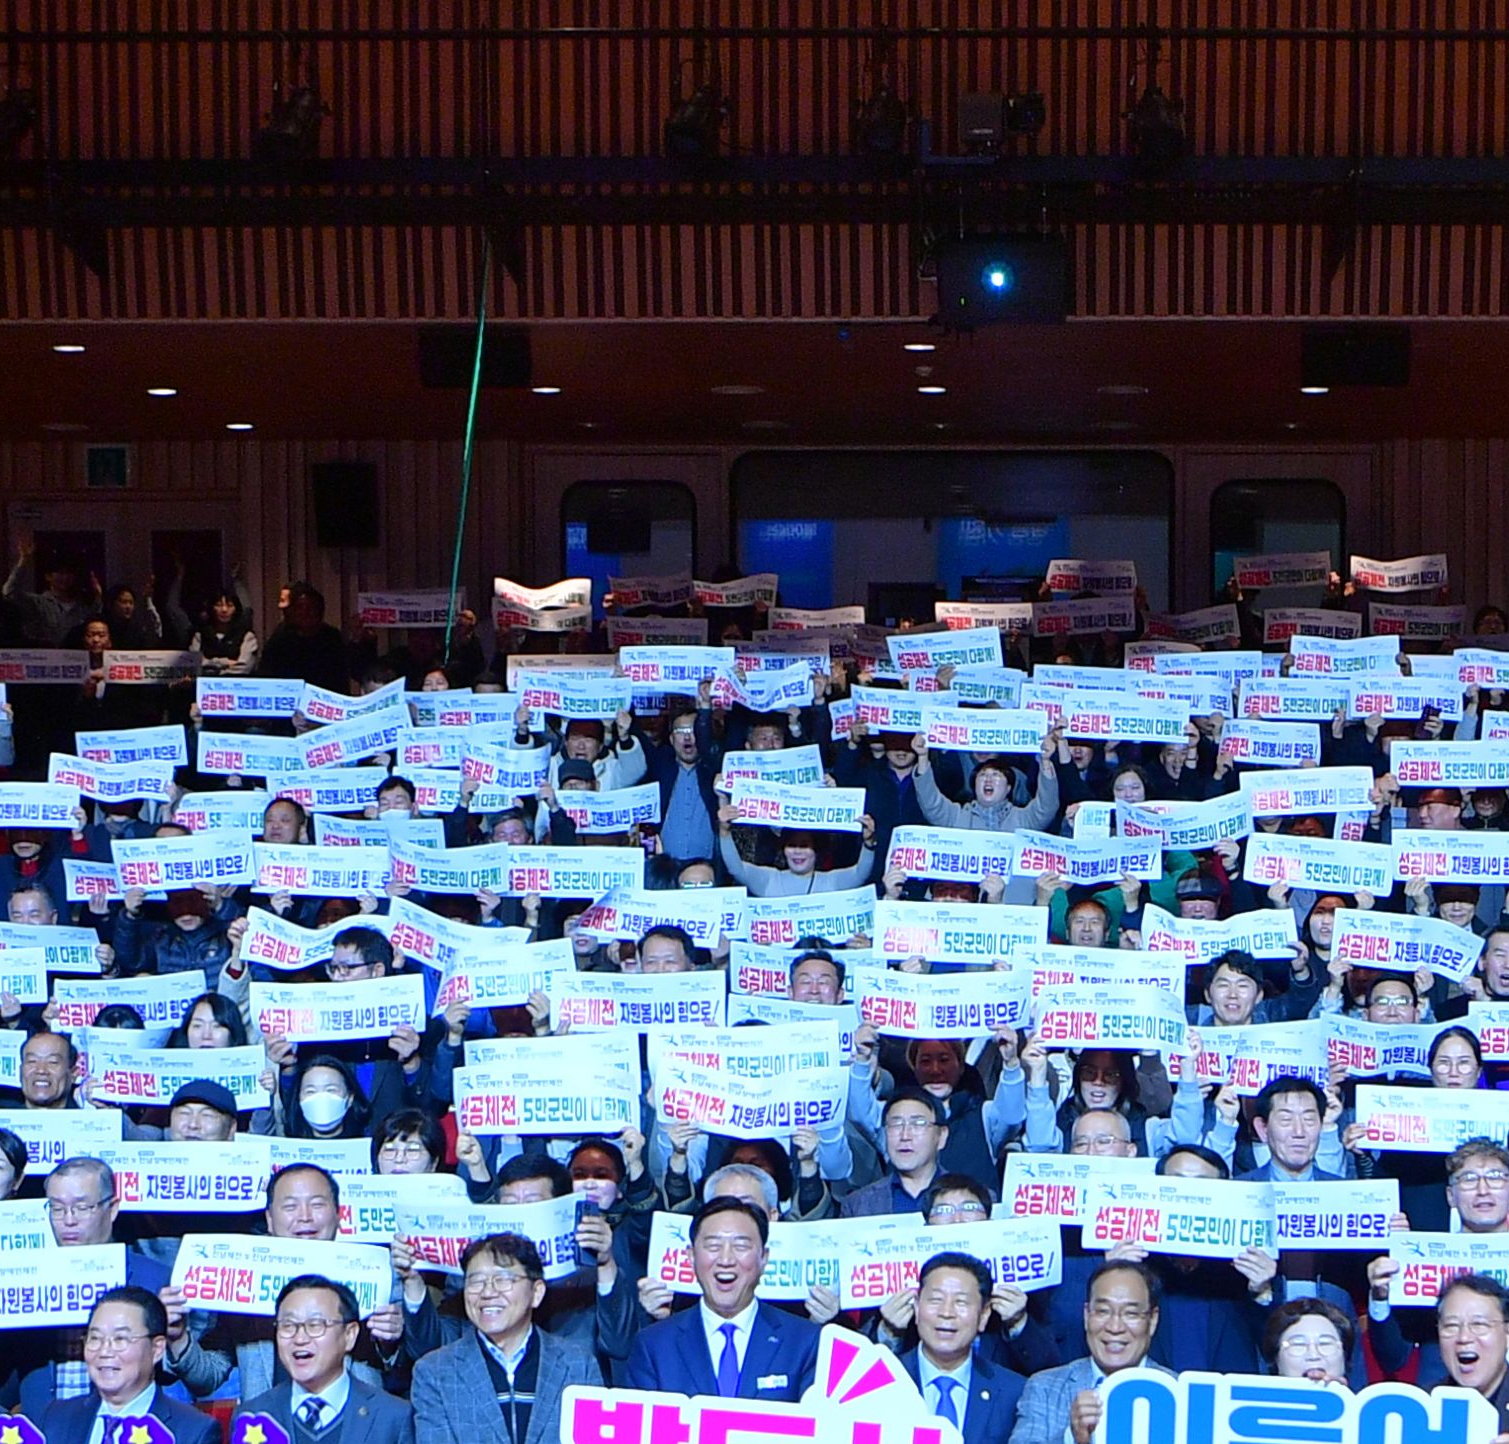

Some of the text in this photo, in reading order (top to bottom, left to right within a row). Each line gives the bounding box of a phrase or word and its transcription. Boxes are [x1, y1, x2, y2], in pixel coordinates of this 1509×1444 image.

[1114, 717, 1154, 733] 5만군민이
[1445, 763, 1486, 779] 5만군민이
[161, 854, 249, 883] 자원봉사의 힘으로!
[1022, 850, 1156, 879] 성공체전, 자원봉사의 힘으로!
[1306, 862, 1354, 884] 5만군민이
[1350, 867, 1385, 887] 다함께!
[1401, 854, 1450, 876] 성공체전,
[1452, 856, 1504, 875] 자원봉사의
[420, 868, 472, 891] 5만군민이
[554, 871, 635, 893] 5만군민이 다함께!
[796, 911, 845, 941] 5만군민이
[1200, 933, 1249, 959] 5만군민이
[322, 1008, 375, 1031] 자원봉사의
[374, 1004, 417, 1030] 힘으로!
[620, 1002, 675, 1024] 자원봉사의
[678, 1001, 717, 1025] 힘으로!
[862, 998, 1030, 1029] 성공체전, 힘으로!
[1041, 1012, 1160, 1039] 성공체전, 5만군민이
[457, 1096, 519, 1126] 성공체전,
[524, 1097, 586, 1122] 5만군민이
[729, 1103, 790, 1129] 자원봉사의
[795, 1100, 844, 1130] 힘으로!
[147, 1175, 211, 1200] 자원봉사의
[1096, 1208, 1236, 1245] 성공체전, 5만군민이
[1277, 1214, 1342, 1238] 자원봉사의
[1001, 1254, 1054, 1282] 힘으로!
[183, 1267, 255, 1302] 성공체전,
